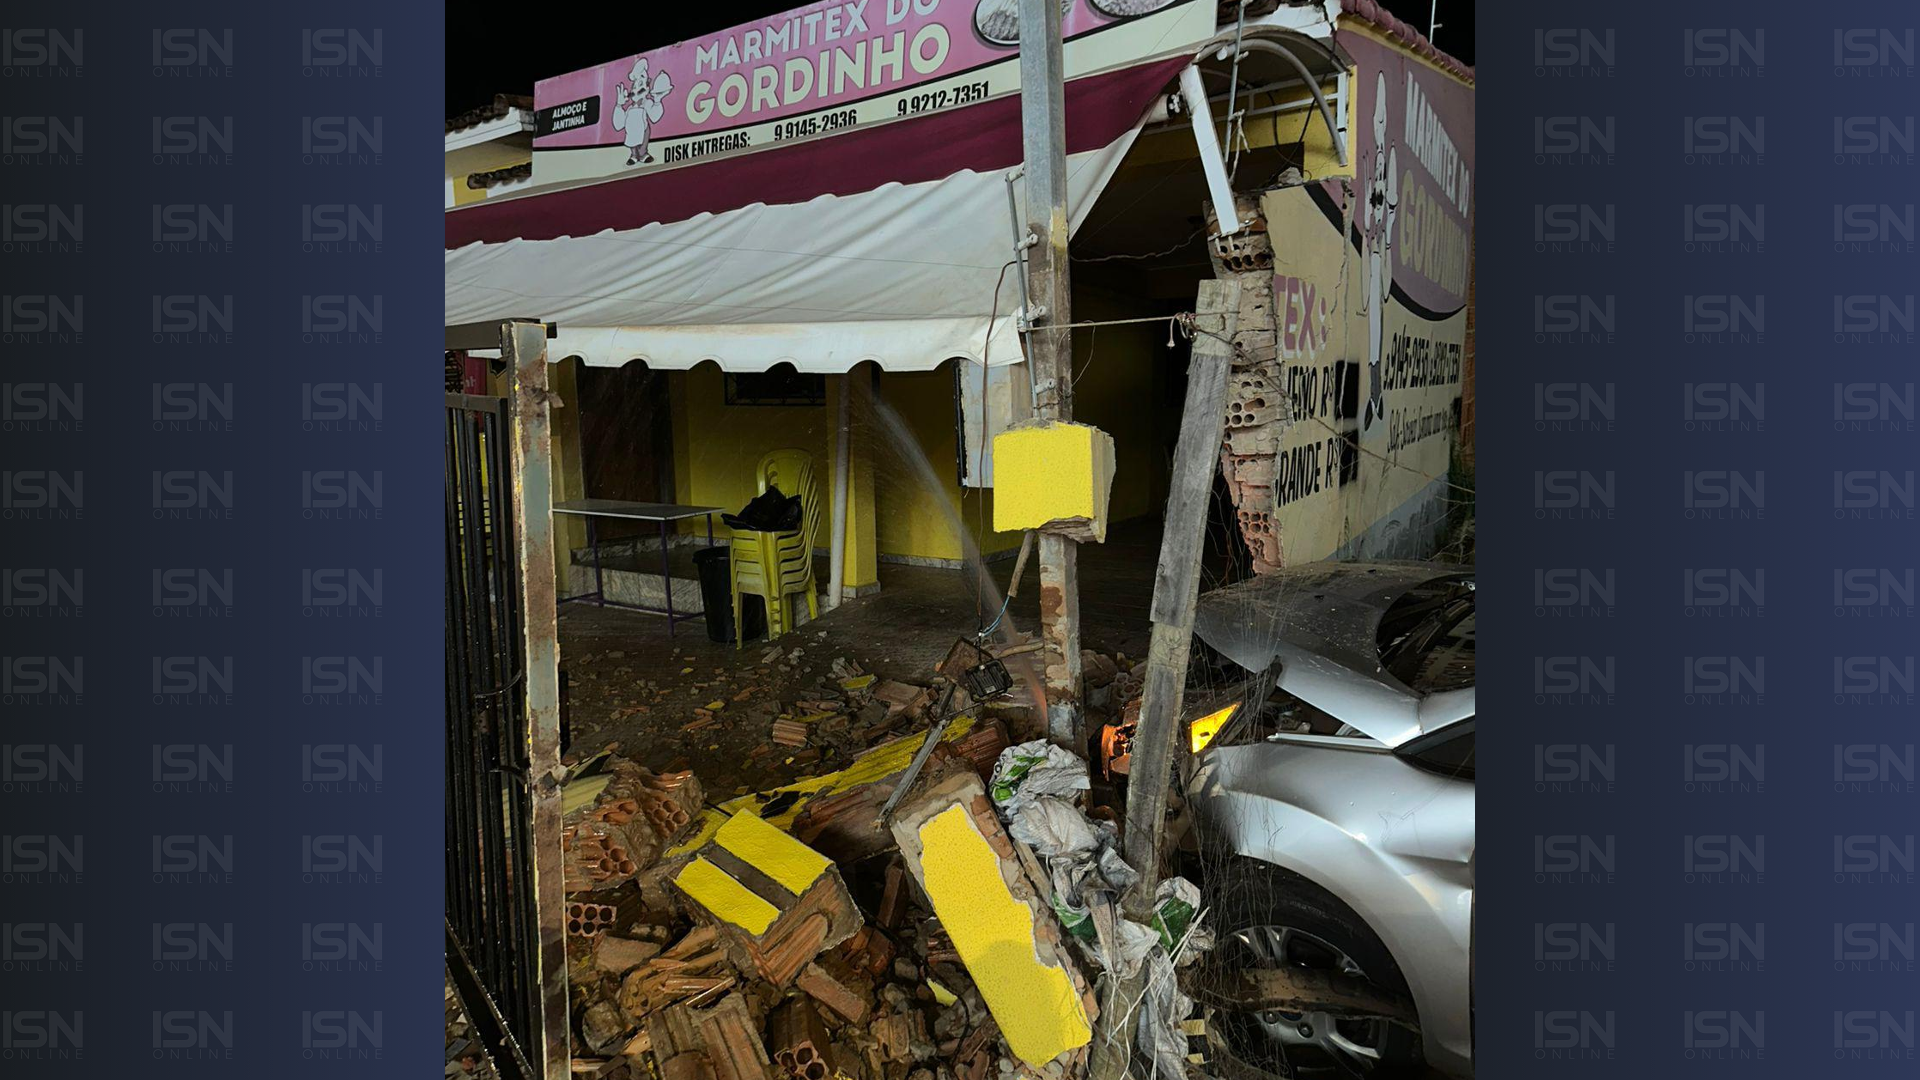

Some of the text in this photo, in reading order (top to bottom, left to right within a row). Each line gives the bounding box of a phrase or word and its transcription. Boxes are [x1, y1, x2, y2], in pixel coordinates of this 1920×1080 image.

[694, 0, 869, 75] MARMITEX
[685, 23, 951, 125] GORDINHO
[911, 80, 989, 114] 9212-7351
[552, 102, 587, 119] ALMOÇO E
[552, 115, 585, 131] JANTINHA
[786, 109, 857, 139] 9145-2936
[1405, 70, 1459, 205] MARMITEX
[664, 131, 750, 163] DISK ENTREGAS:
[1400, 169, 1467, 298] GORDINHO
[1288, 366, 1317, 421] ENO
[1275, 441, 1322, 508] RANDE
